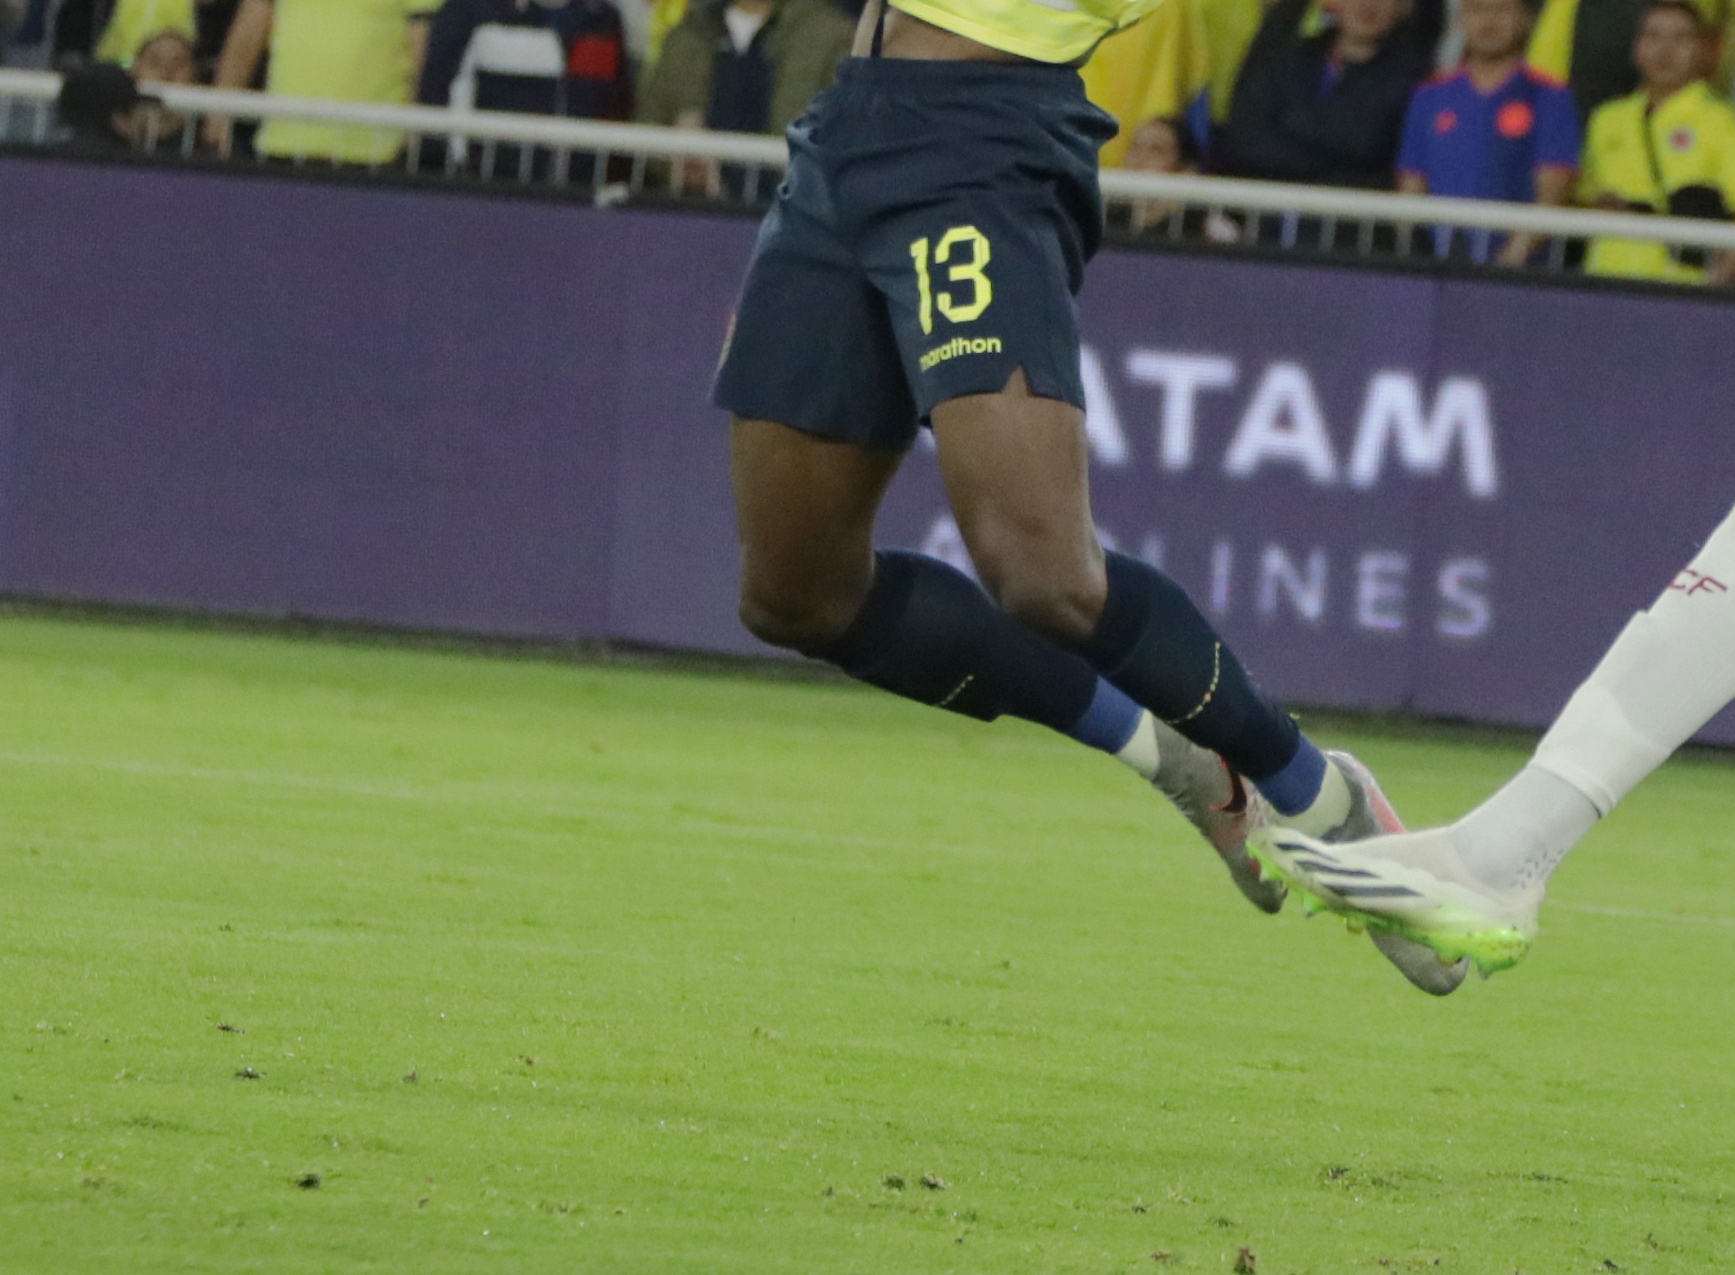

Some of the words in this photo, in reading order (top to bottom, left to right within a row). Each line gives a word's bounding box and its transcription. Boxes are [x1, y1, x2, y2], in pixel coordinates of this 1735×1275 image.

[910, 225, 993, 335] 13
[918, 337, 1002, 372] marathon
[1669, 569, 1728, 596] CF
